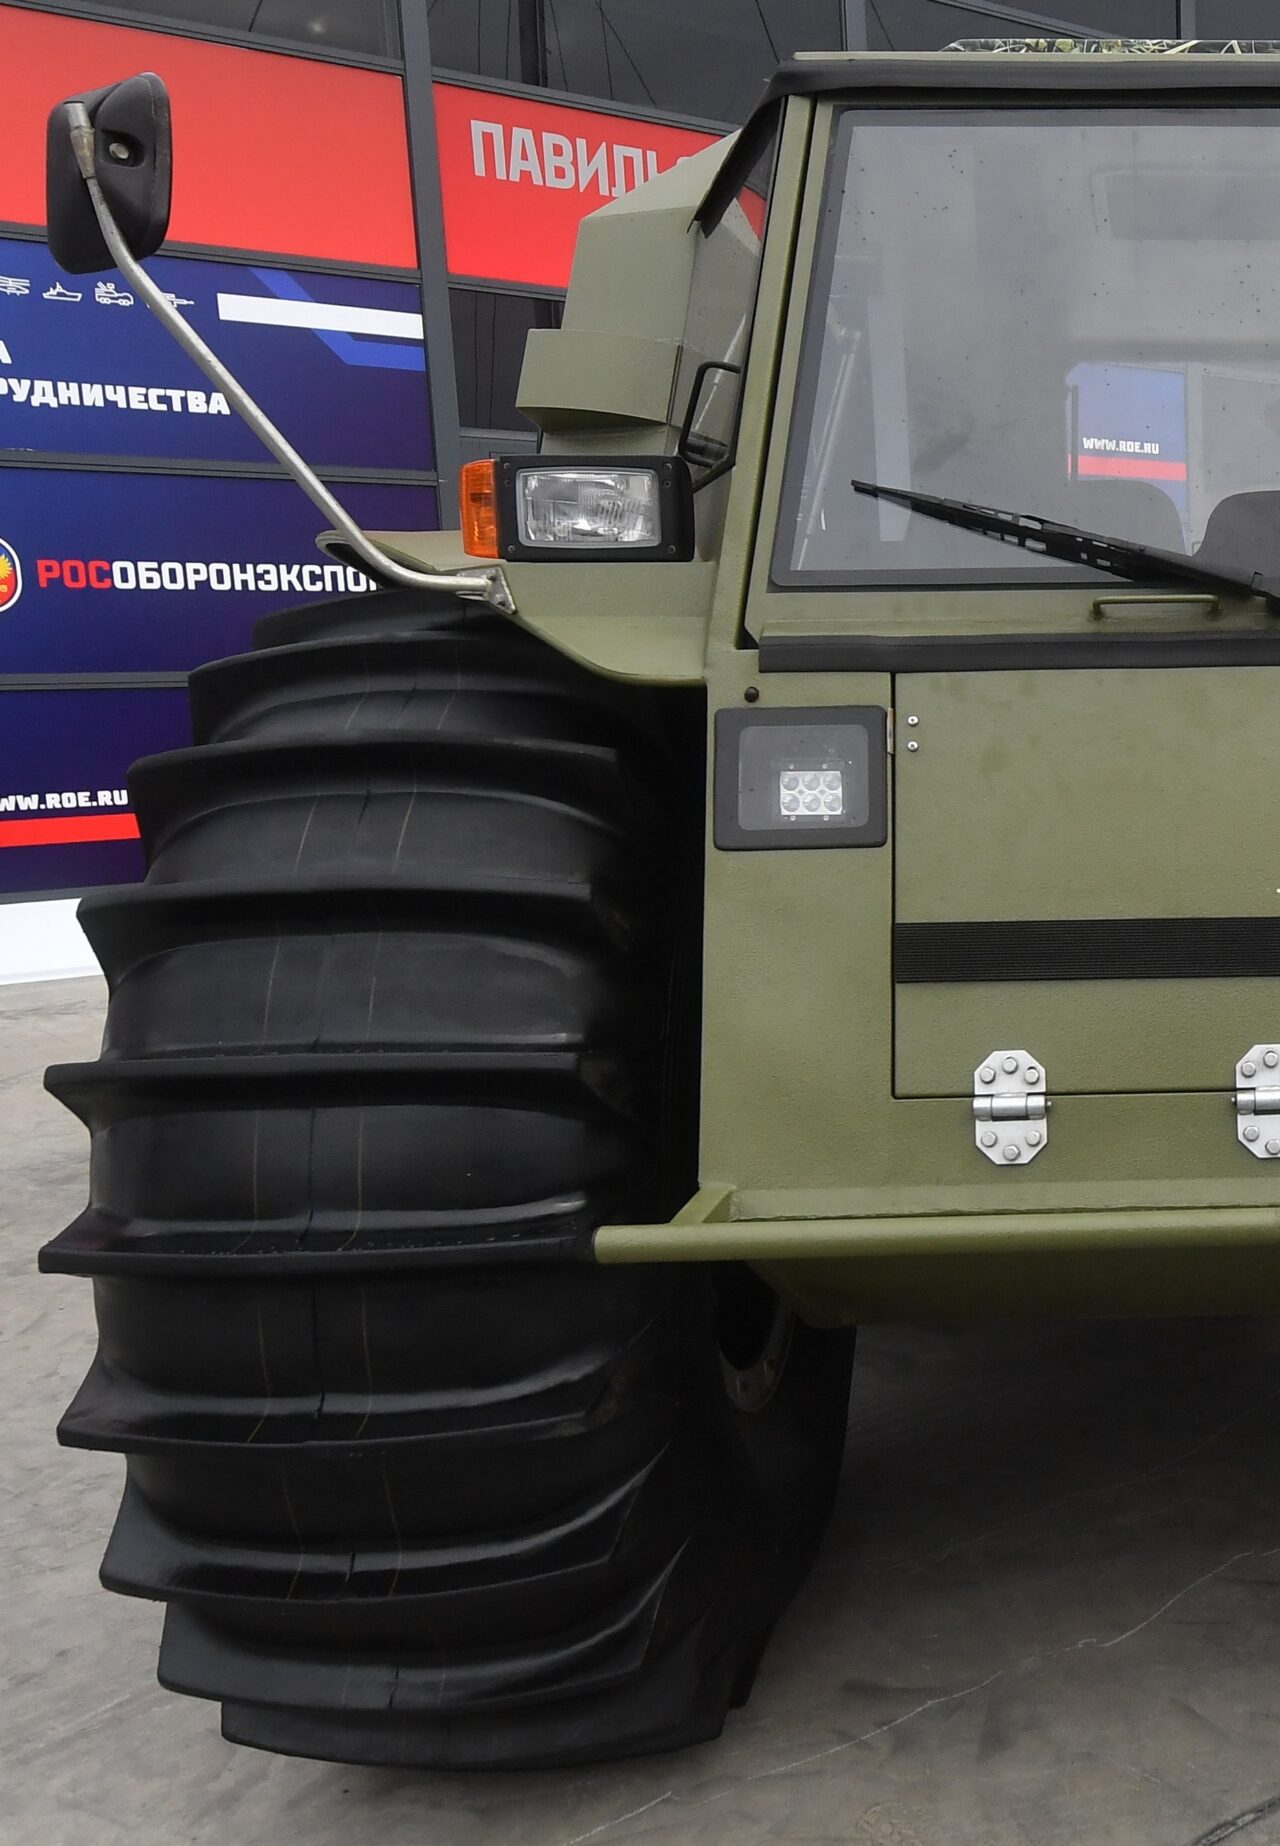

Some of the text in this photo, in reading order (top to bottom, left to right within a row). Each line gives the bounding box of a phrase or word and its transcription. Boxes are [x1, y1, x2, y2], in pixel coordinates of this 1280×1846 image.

[470, 119, 692, 197] ПАВИЛ
[1082, 437, 1159, 454] WWW.ROE.RU
[36, 559, 377, 592] РОСОБОРОНЭКСПО
